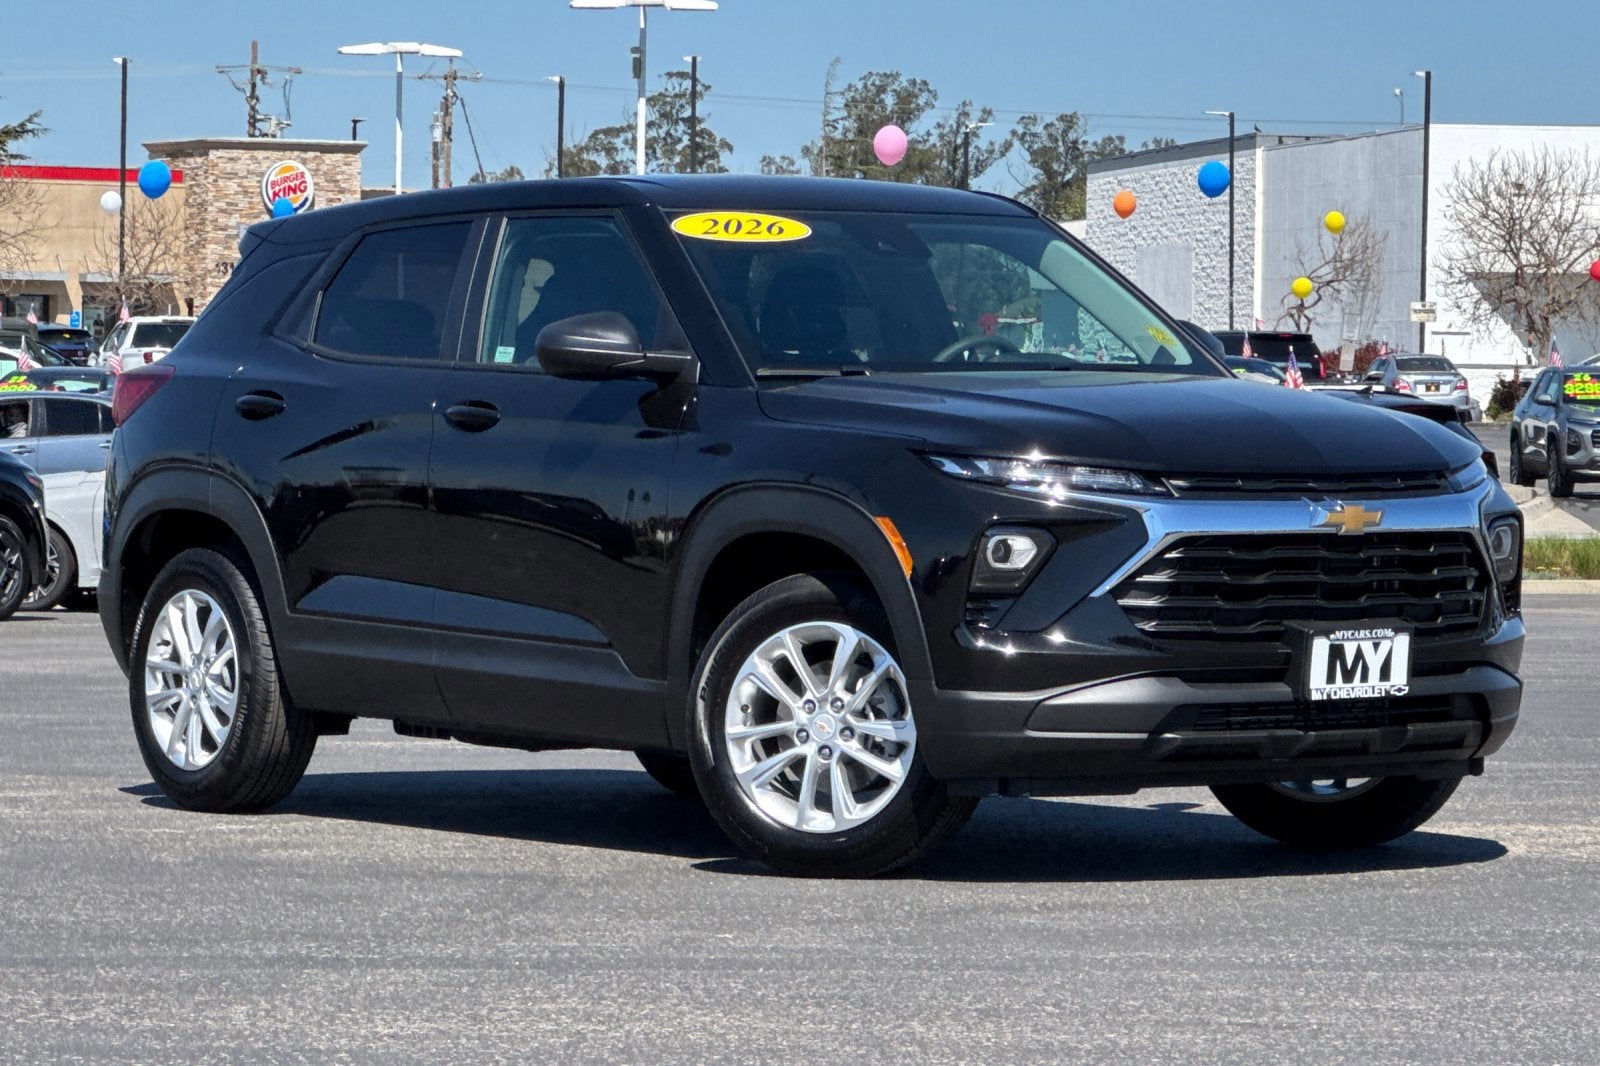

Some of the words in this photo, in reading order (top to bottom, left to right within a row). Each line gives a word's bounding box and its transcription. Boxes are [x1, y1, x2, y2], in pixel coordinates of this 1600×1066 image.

[270, 171, 305, 190] BURGER
[271, 180, 307, 203] KING
[701, 218, 785, 236] 2026
[1335, 628, 1392, 640] MYCARS.COM
[1326, 641, 1393, 685] MY
[1311, 687, 1327, 701] MY
[1330, 686, 1386, 700] CHEVROLET
